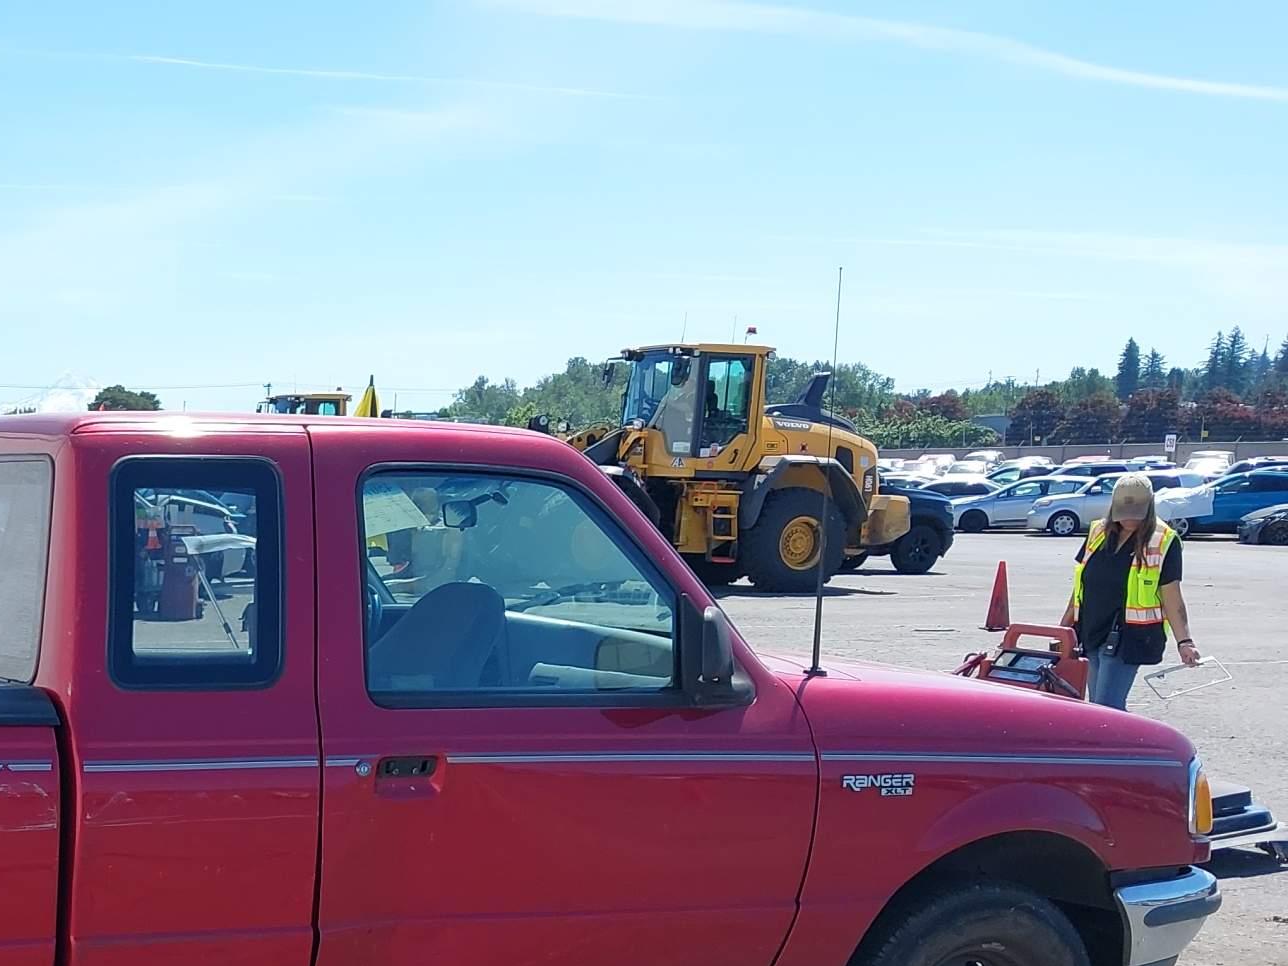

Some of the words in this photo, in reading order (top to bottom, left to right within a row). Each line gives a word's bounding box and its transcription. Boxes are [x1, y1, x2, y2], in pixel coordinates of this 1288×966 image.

[775, 420, 809, 430] VOLVO
[842, 773, 915, 791] RANGER
[881, 787, 913, 796] XLT
